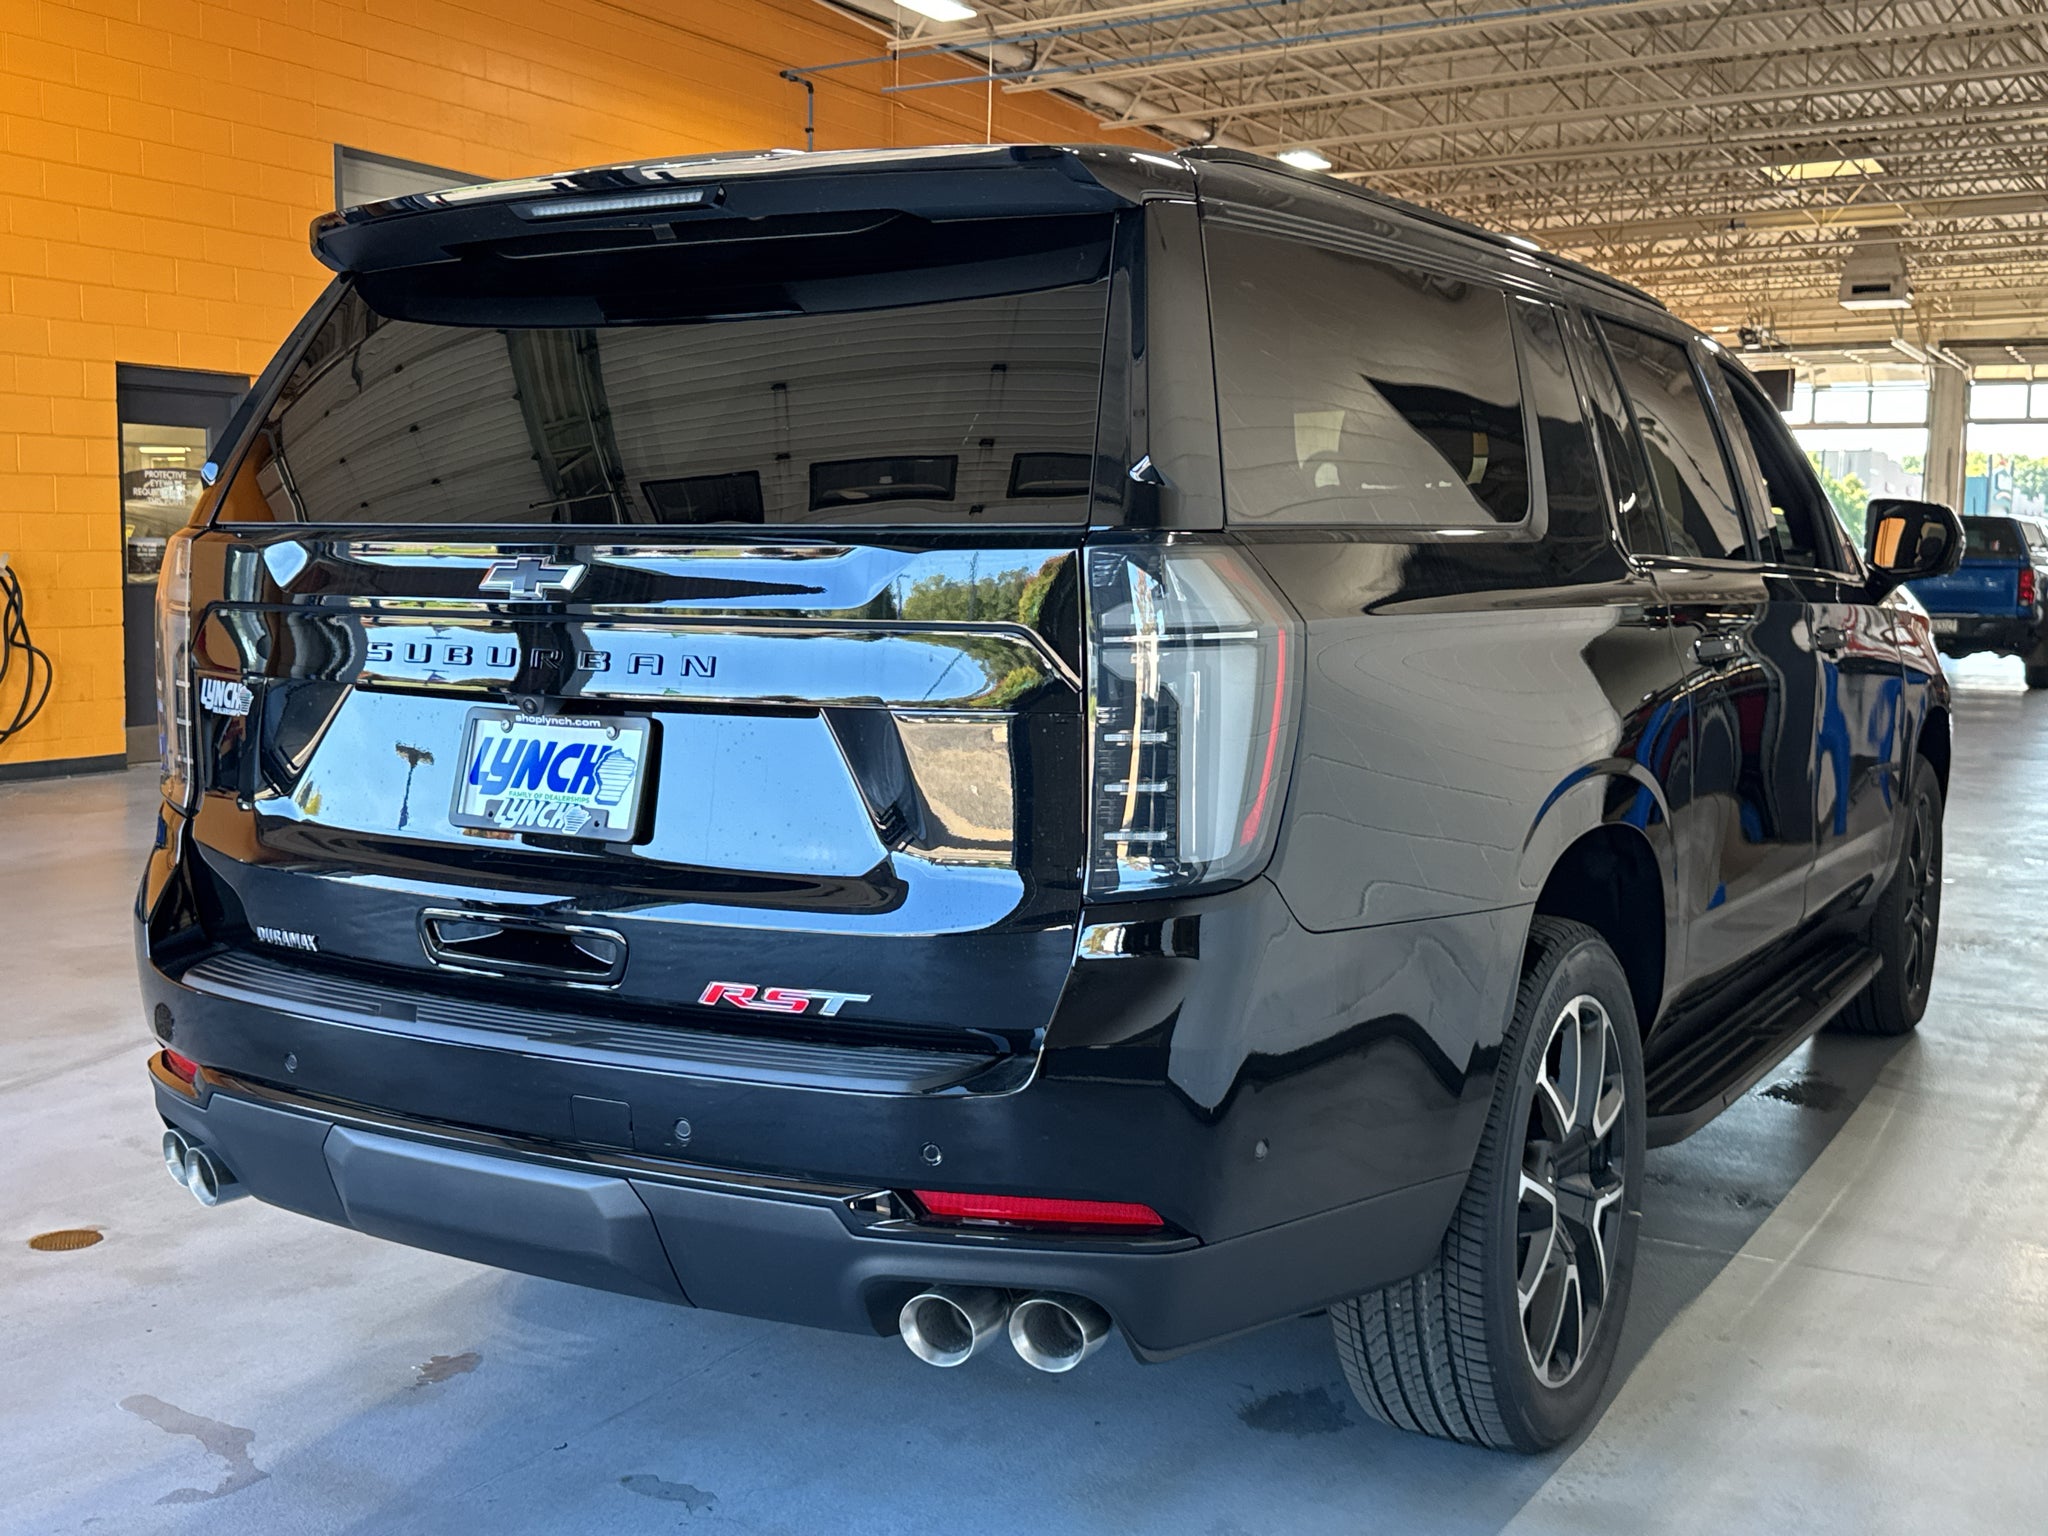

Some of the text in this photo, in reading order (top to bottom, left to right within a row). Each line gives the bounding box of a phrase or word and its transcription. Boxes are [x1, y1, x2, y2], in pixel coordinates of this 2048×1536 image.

[144, 470, 187, 480] PROTECTIVE
[366, 642, 717, 678] SUBURBAN
[201, 678, 243, 710] LYNCH
[515, 714, 601, 728] shoplynch.com
[469, 736, 613, 795] LYNCH
[508, 790, 532, 799] FAMILY
[544, 793, 590, 804] DEALERSHIPS
[493, 798, 572, 829] LYNCH
[256, 926, 318, 952] DURAMAX
[697, 980, 874, 1017] RST
